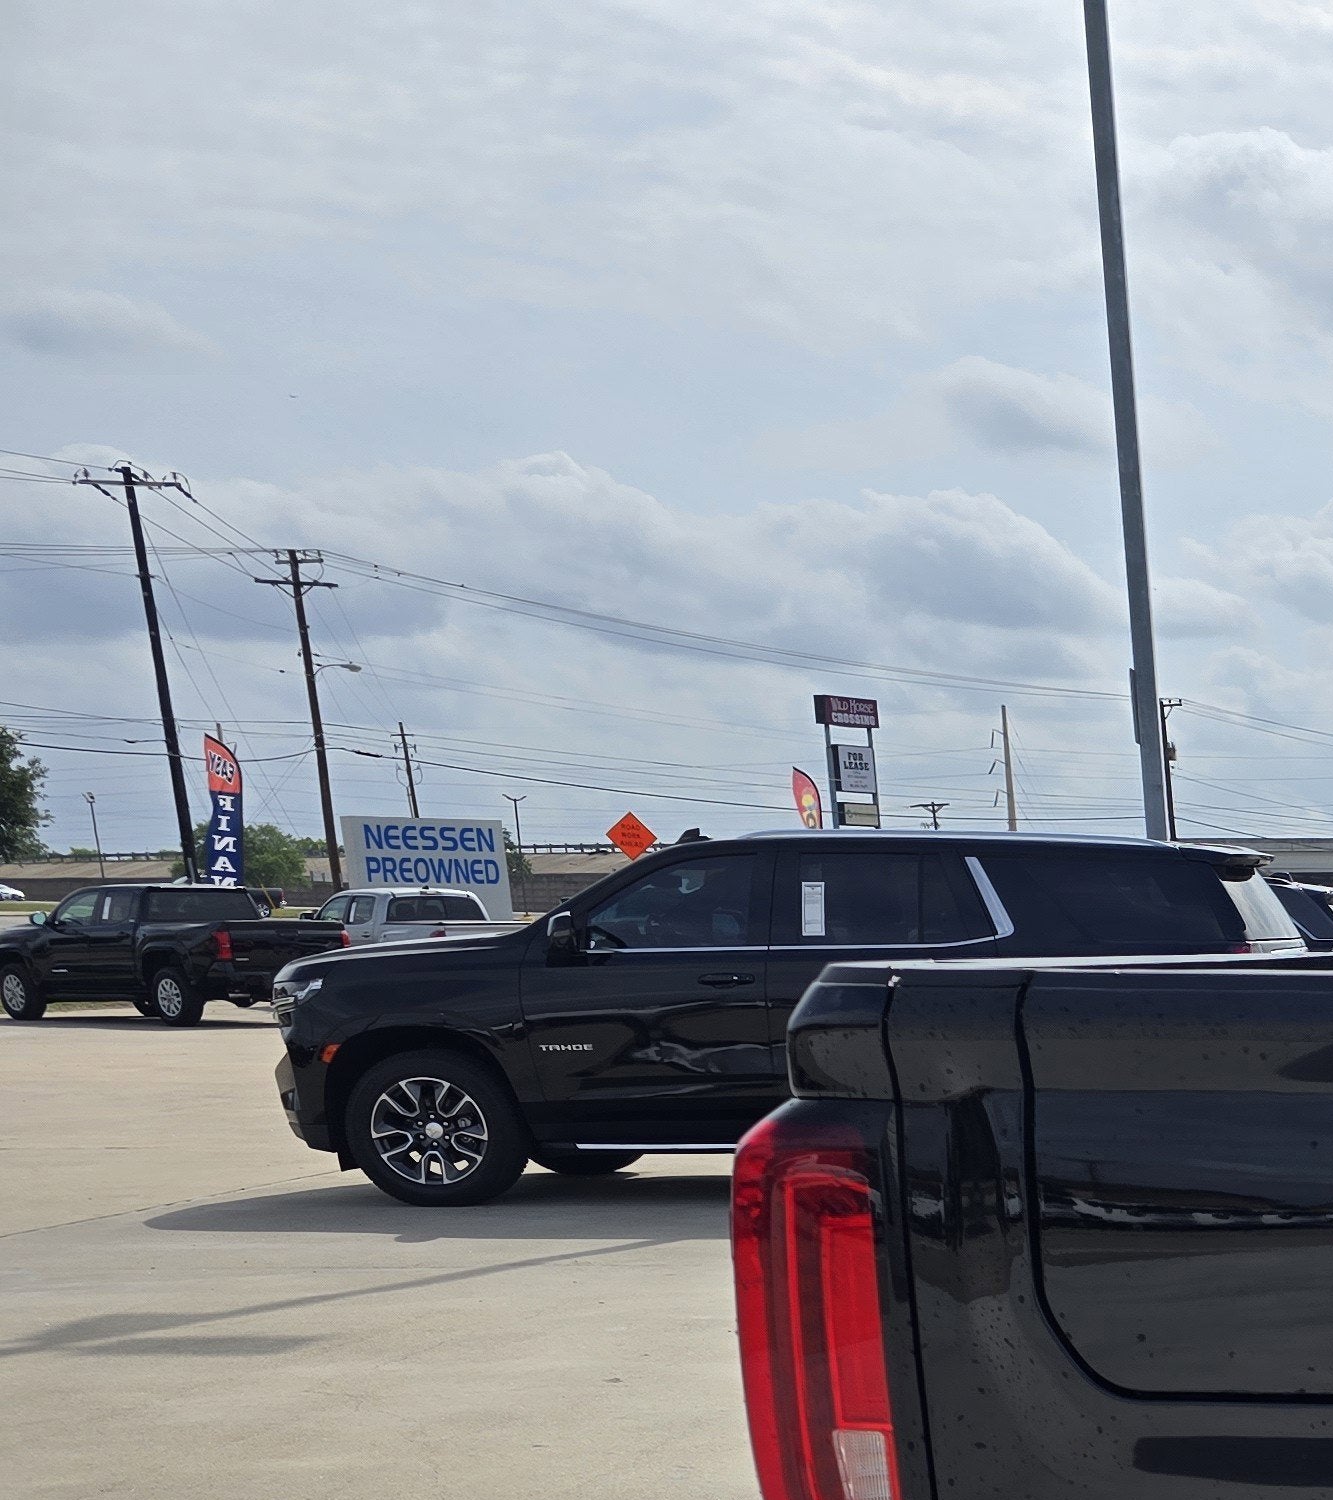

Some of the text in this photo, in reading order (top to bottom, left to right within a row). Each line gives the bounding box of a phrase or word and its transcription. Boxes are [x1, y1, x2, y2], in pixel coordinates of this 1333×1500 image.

[849, 699, 874, 713] HORSE
[831, 711, 876, 726] CROSSING
[847, 751, 864, 761] FOR
[843, 761, 870, 771] LEASE
[363, 824, 495, 852] NEESSEN
[365, 856, 500, 885] PREOWNED
[539, 1043, 594, 1052] TAHOE
